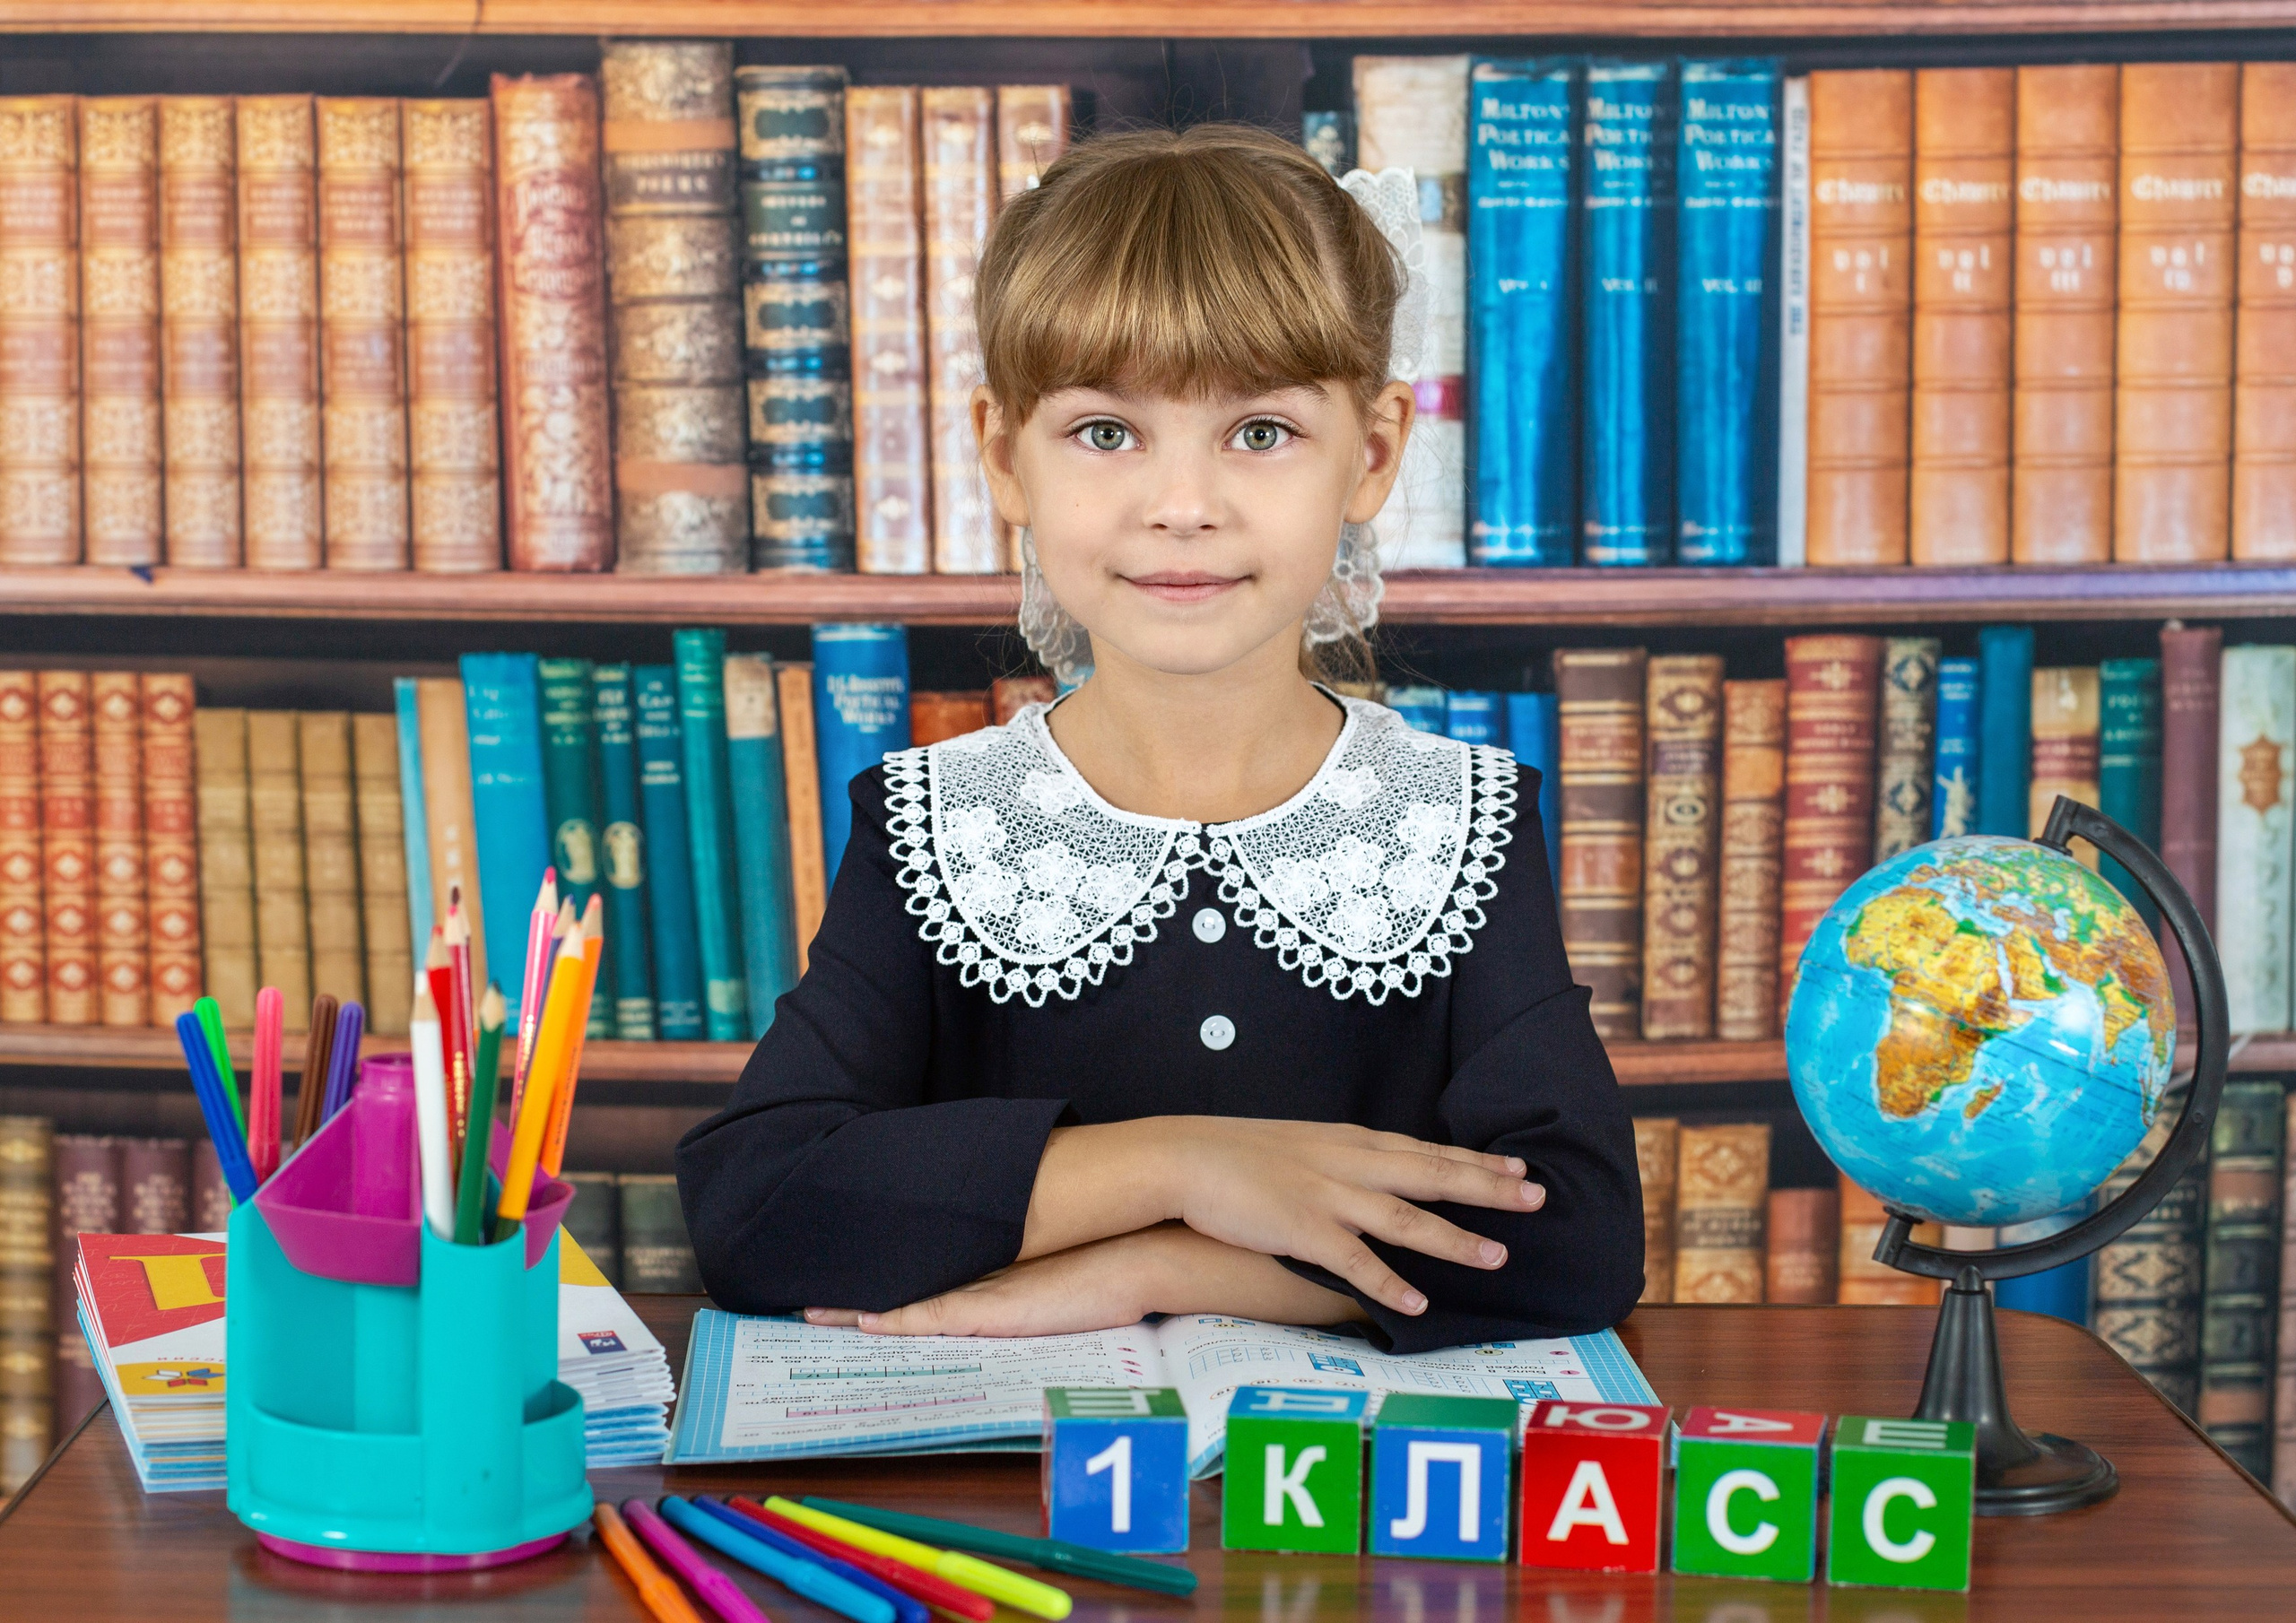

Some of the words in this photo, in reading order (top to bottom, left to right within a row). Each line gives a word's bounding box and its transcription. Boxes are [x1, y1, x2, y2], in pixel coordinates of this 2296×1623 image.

[1545, 1405, 1650, 1431] Ю
[1708, 1412, 1793, 1434] А
[1085, 1436, 1131, 1533] 1
